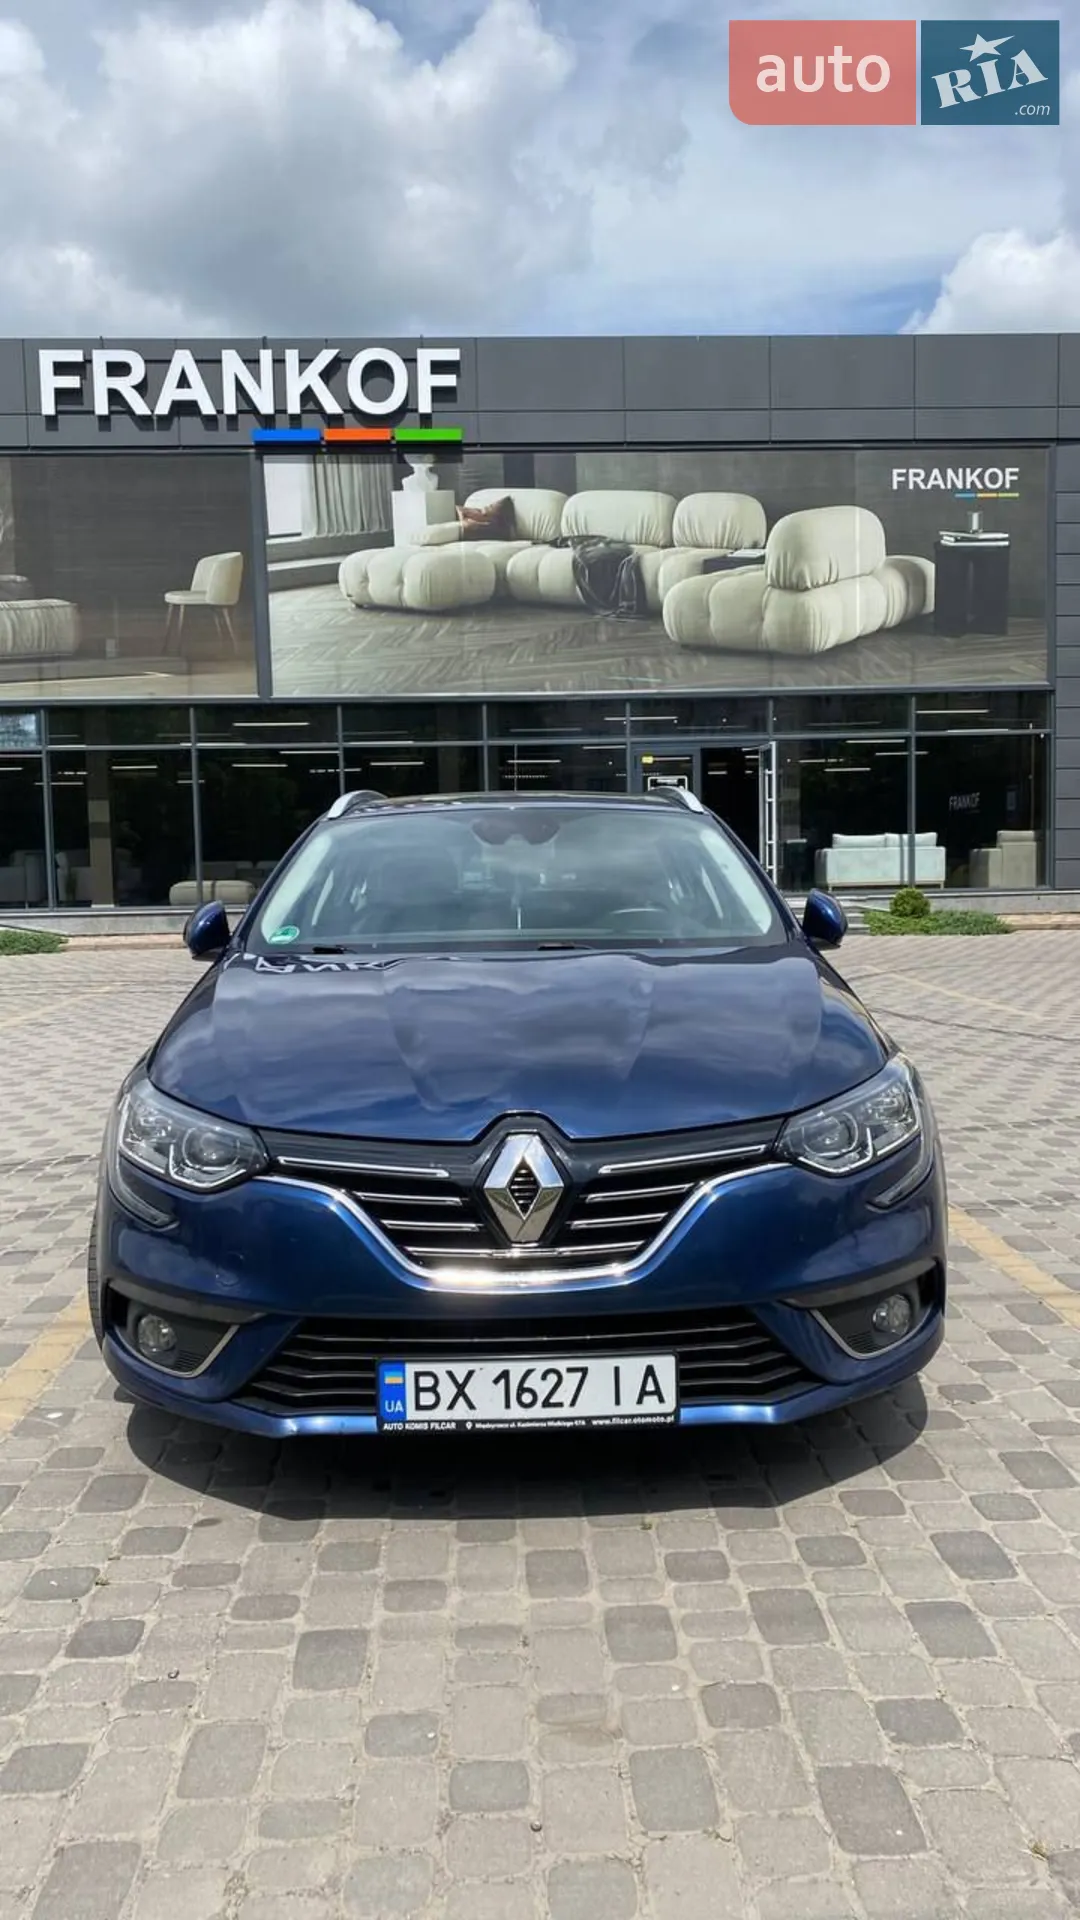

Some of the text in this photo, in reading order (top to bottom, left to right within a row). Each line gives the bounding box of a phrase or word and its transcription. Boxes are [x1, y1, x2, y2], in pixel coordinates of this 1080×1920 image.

[38, 347, 461, 416] FRANKOF
[892, 467, 1020, 490] FRANKOF
[413, 1369, 477, 1411] BX
[492, 1366, 589, 1409] 1627
[384, 1400, 404, 1413] UA
[383, 1421, 457, 1430] AUTO KOMIS FILCAR
